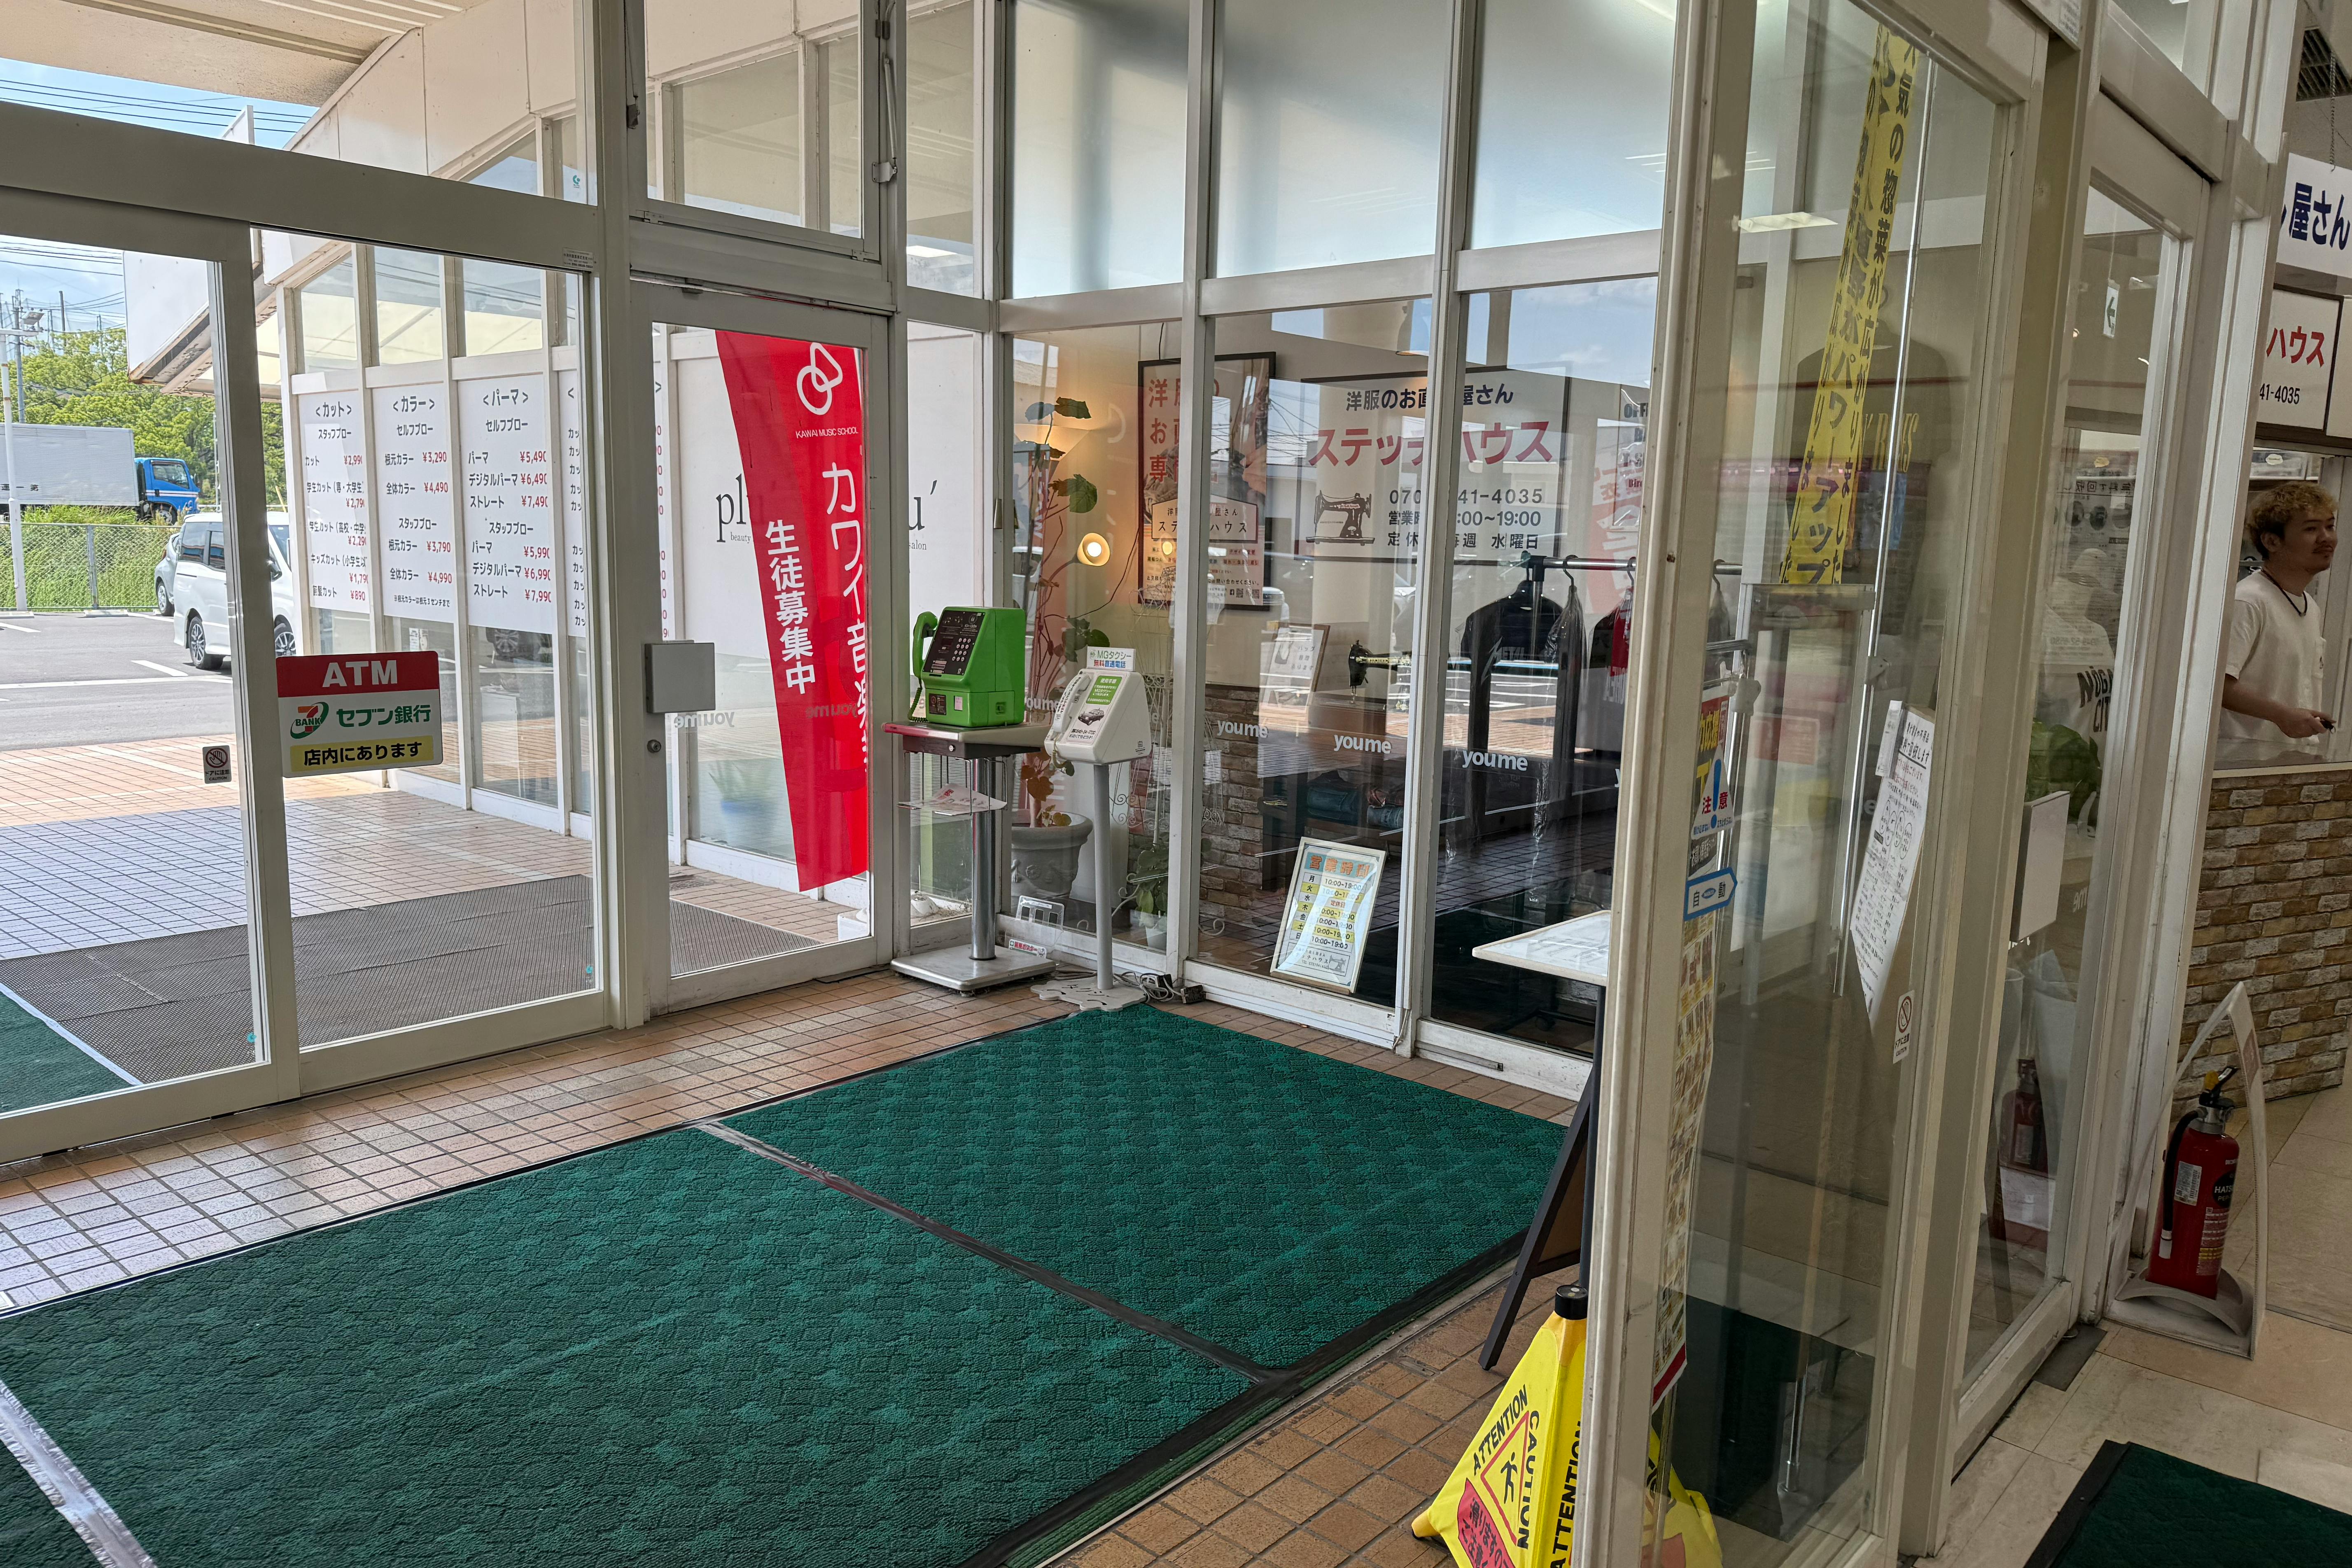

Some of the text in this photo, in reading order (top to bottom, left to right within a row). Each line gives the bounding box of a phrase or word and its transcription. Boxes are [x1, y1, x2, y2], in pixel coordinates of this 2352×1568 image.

[2281, 182, 2350, 250] 屋さん
[397, 423, 433, 436] セルフブロー
[486, 418, 528, 432] セルフブロー
[796, 427, 859, 439] KAWAI MUSIC SCHOOL
[385, 452, 447, 465] 根元カラー ¥3,290
[469, 451, 488, 464] パーマ
[469, 473, 518, 486] デジタルパーマ
[387, 482, 448, 495] 全体カラー ¥4,490
[470, 495, 504, 509] ストレート
[399, 518, 437, 530] スタッフブロー
[489, 522, 534, 535] スタッフブロー
[730, 532, 751, 543] beauty
[389, 539, 451, 553] 根元カラー ¥3,790
[472, 540, 492, 553] パーマ
[390, 567, 452, 584] 全体カラー ¥4,990
[473, 562, 521, 577] デジタルパーマ
[351, 590, 365, 601] ¥890
[474, 584, 508, 598] ストレート
[765, 520, 816, 695] 生徒募集中
[1097, 650, 1132, 660] MGタクシー
[1094, 660, 1126, 669] 無料直通電話
[322, 659, 397, 688] ATM
[295, 717, 321, 726] BANK
[336, 705, 431, 727] セブン銀行
[1217, 720, 1268, 738] youme
[1334, 734, 1392, 754] youme
[304, 742, 422, 766] 店内にあります
[1462, 749, 1528, 771] youme
[1702, 791, 1728, 814] 注意
[1310, 855, 1370, 878] 営業時間
[1473, 1384, 1528, 1476] ATTENTION
[1516, 1410, 1540, 1549] CAUTION
